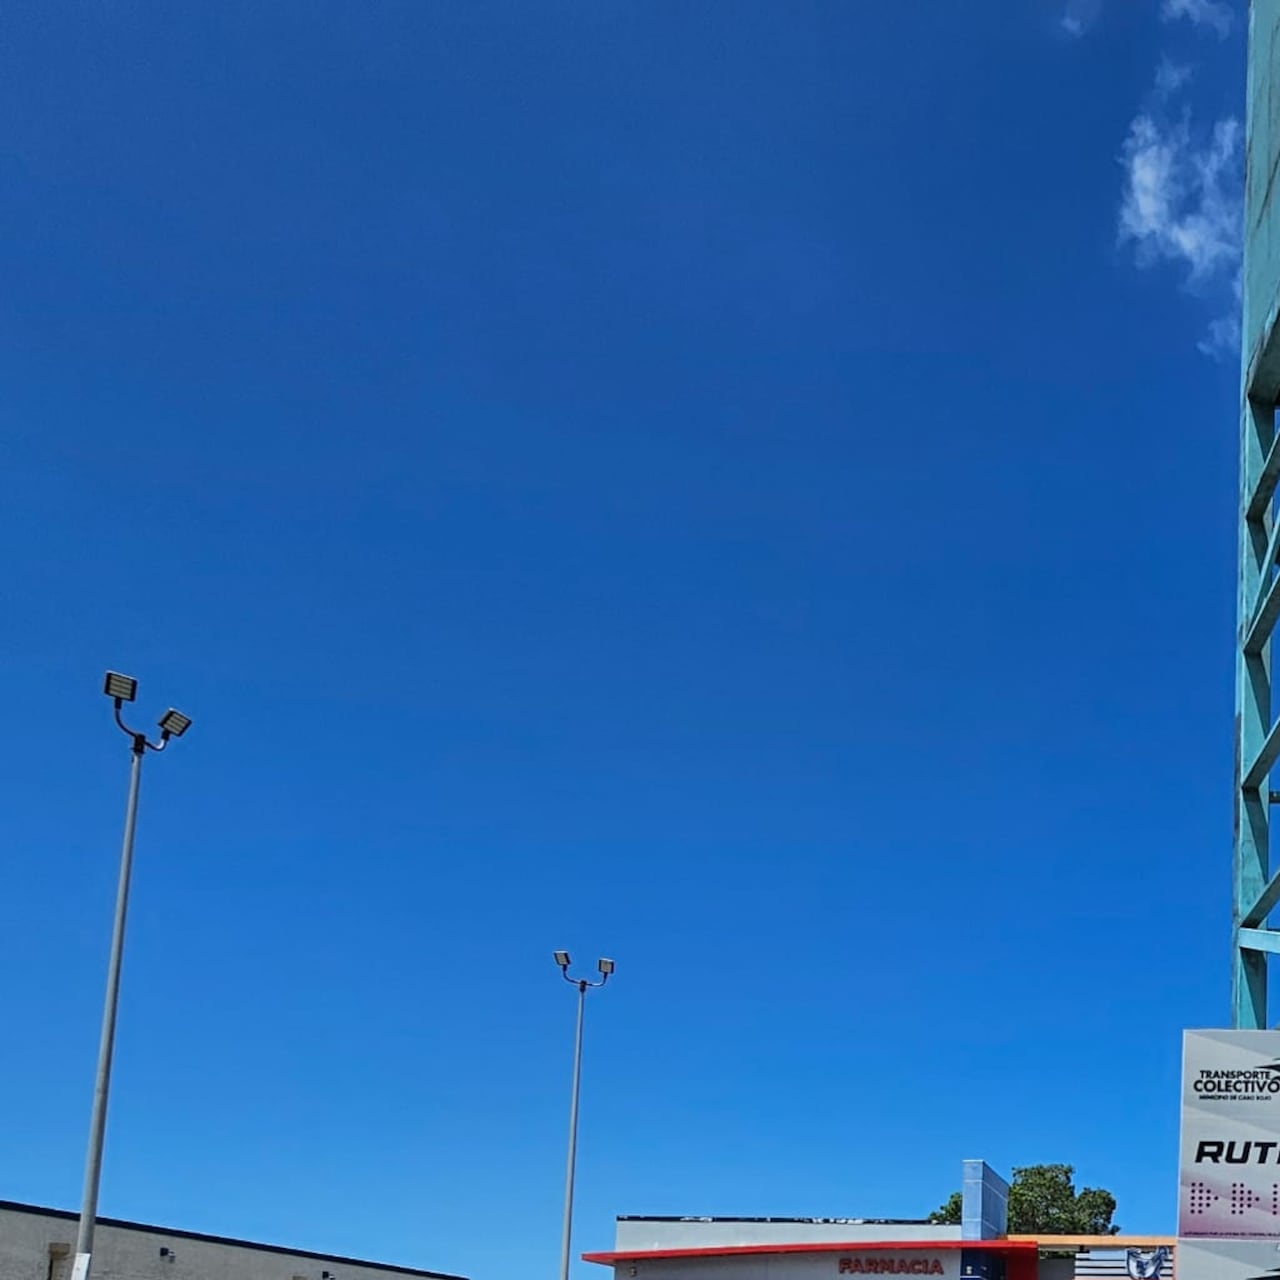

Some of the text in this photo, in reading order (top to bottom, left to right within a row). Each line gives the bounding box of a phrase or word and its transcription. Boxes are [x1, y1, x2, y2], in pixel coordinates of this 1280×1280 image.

[1199, 1069, 1271, 1080] TRANSPORTE
[1193, 1079, 1280, 1094] COLECTIVO
[838, 1257, 945, 1275] FARMACIA
